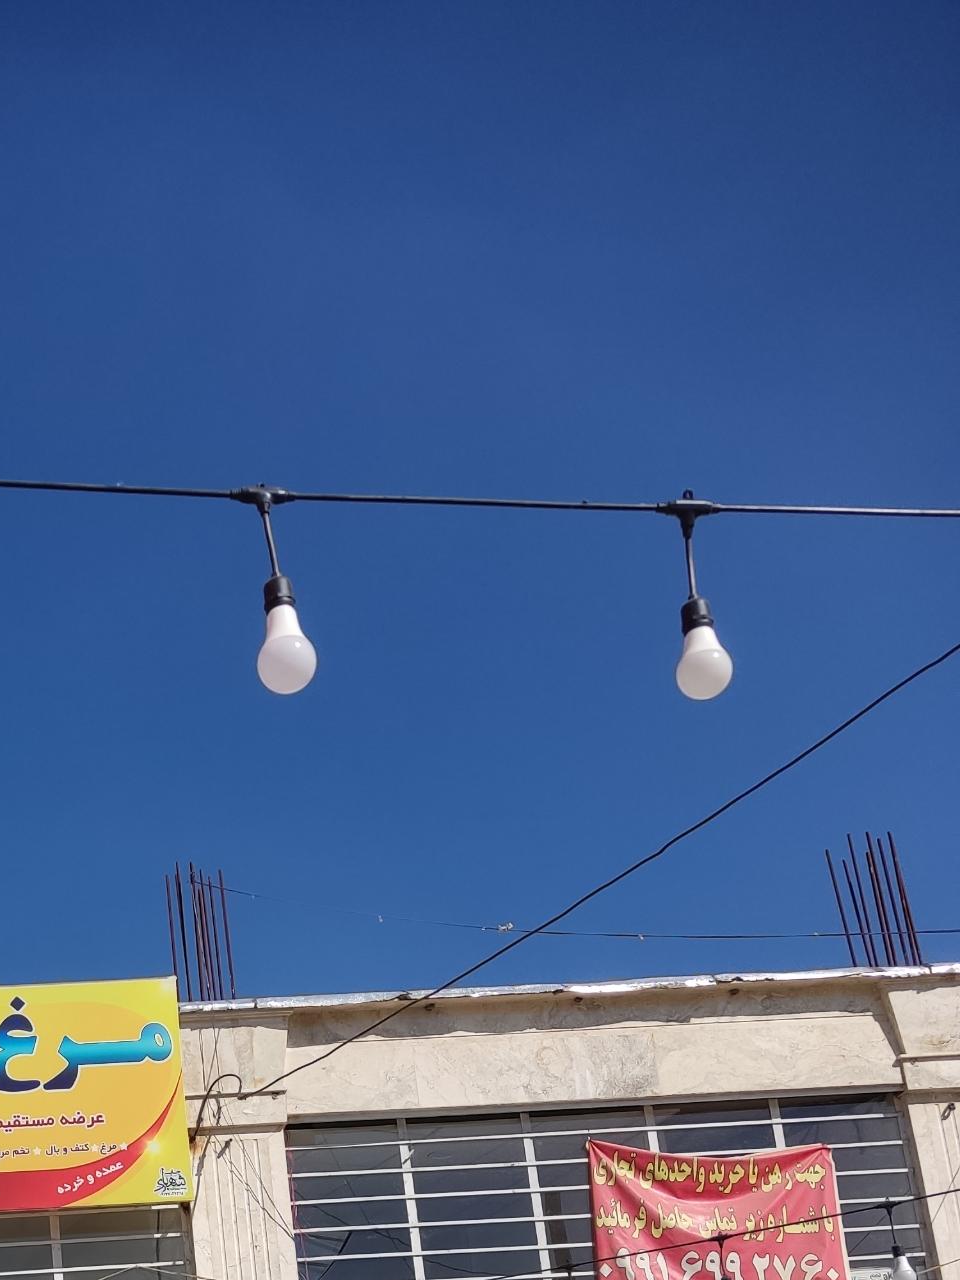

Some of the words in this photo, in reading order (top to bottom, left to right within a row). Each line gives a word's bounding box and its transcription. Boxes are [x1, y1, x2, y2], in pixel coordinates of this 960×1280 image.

[59, 1111, 105, 1128] عرضه
[12, 1147, 30, 1156] تخم
[45, 1145, 60, 1156] بال
[62, 1146, 68, 1155] و
[70, 1143, 90, 1153] کتف
[100, 1143, 117, 1154] مرغ
[86, 1174, 95, 1184] و
[96, 1161, 124, 1179] عمده
[593, 1151, 636, 1187] تجاری
[640, 1153, 705, 1193] واحدهای
[709, 1158, 745, 1194] خرید
[748, 1157, 759, 1192] یا
[761, 1163, 791, 1192] رهن
[795, 1161, 826, 1189] جهت
[57, 1175, 84, 1195] خرده
[596, 1198, 648, 1238] فرمائید
[651, 1202, 692, 1238] حاصل
[699, 1206, 737, 1239] تماس
[743, 1208, 764, 1241] زیر
[767, 1205, 820, 1243] شماره
[824, 1205, 835, 1240] با
